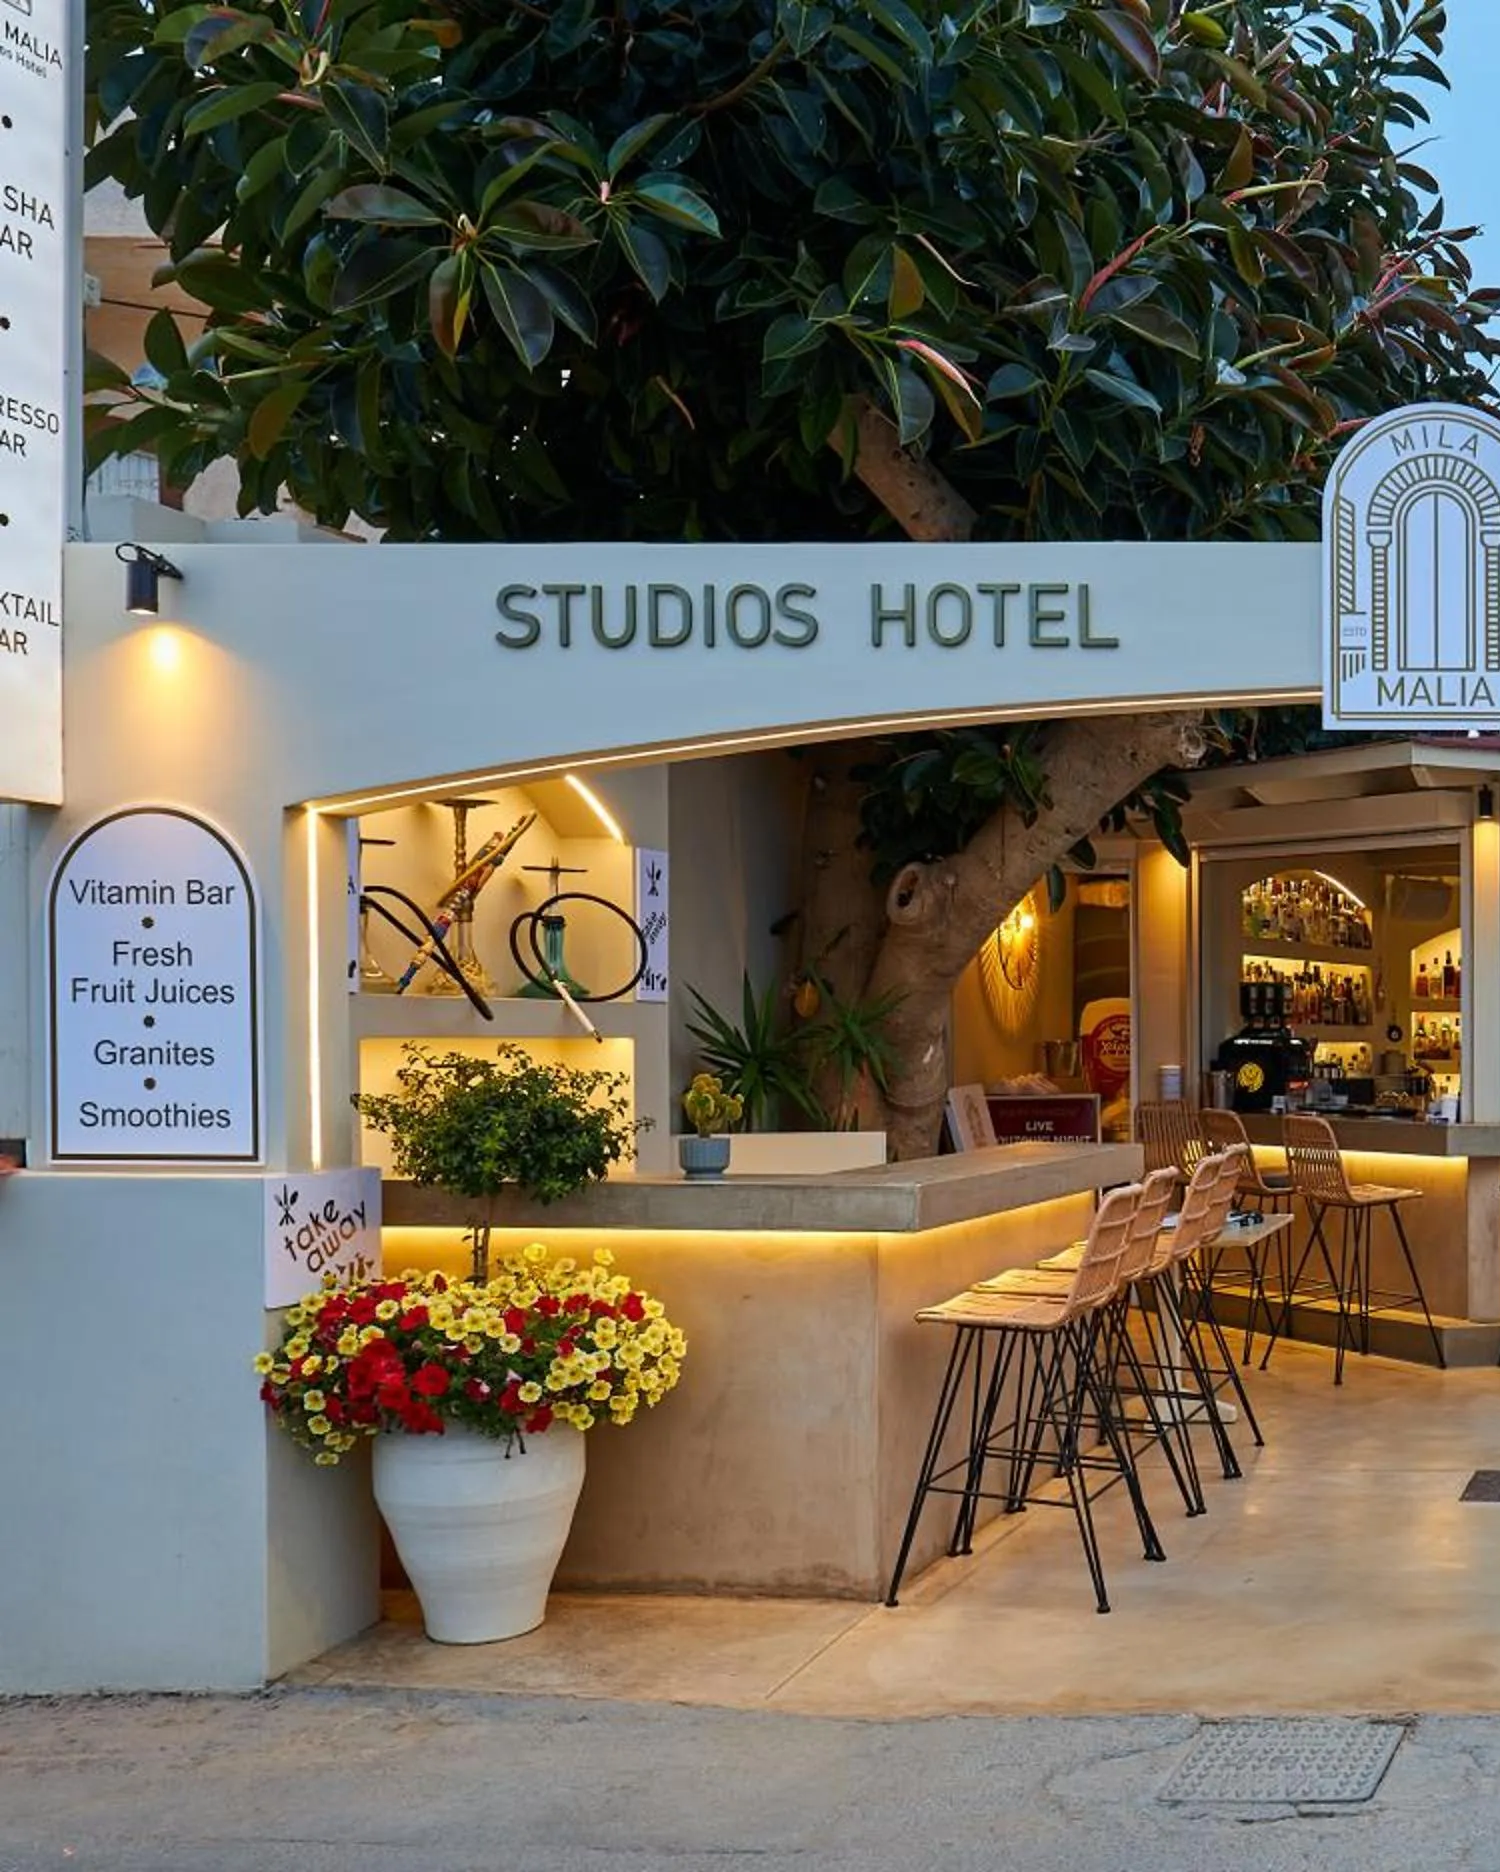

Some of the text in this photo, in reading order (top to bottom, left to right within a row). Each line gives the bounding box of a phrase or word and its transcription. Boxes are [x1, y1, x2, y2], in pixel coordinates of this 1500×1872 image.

[5, 20, 63, 71] MALIA
[1390, 424, 1480, 457] MILA
[495, 582, 1120, 648] STUDIOS HOTEL
[1377, 675, 1496, 707] MALIA
[69, 880, 235, 905] Vitamin Bar
[113, 941, 193, 966] Fresh
[72, 978, 235, 1004] Fruit Juices
[94, 1039, 215, 1066] Granites
[79, 1101, 231, 1129] Smoothies
[1025, 1121, 1054, 1132] LIVE
[284, 1200, 340, 1262] take
[306, 1200, 367, 1273] away
